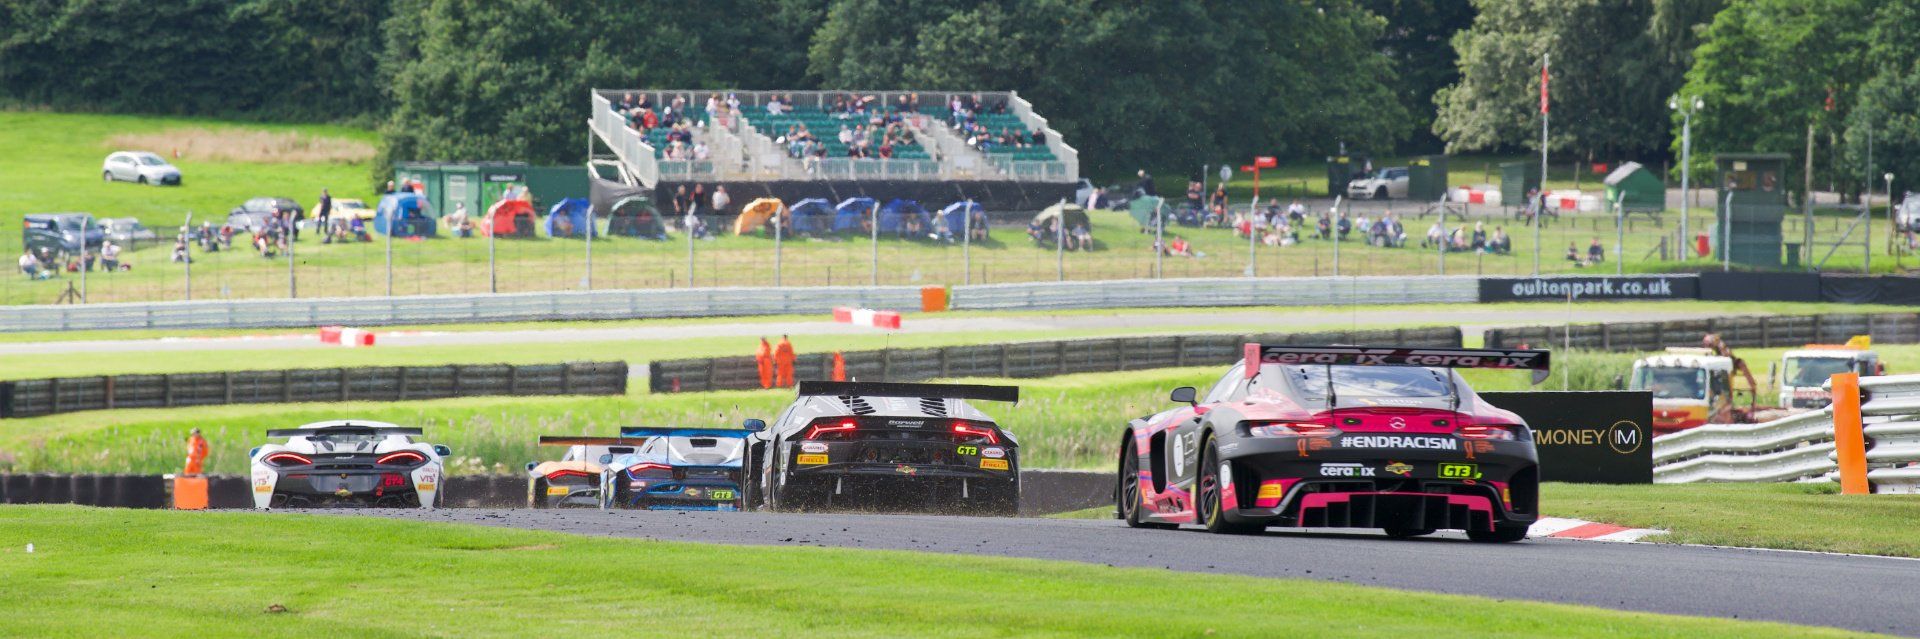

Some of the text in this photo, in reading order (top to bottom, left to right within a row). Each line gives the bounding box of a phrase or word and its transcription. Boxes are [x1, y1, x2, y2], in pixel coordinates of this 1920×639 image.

[1511, 279, 1671, 299] oultonpark.co.uk
[1262, 349, 1391, 365] ceraix
[1405, 352, 1531, 368] ceraix
[1340, 436, 1457, 450] #ENDRACISM
[957, 446, 978, 456] GT3
[1320, 464, 1376, 477] ceraix
[1443, 465, 1471, 477] GT3
